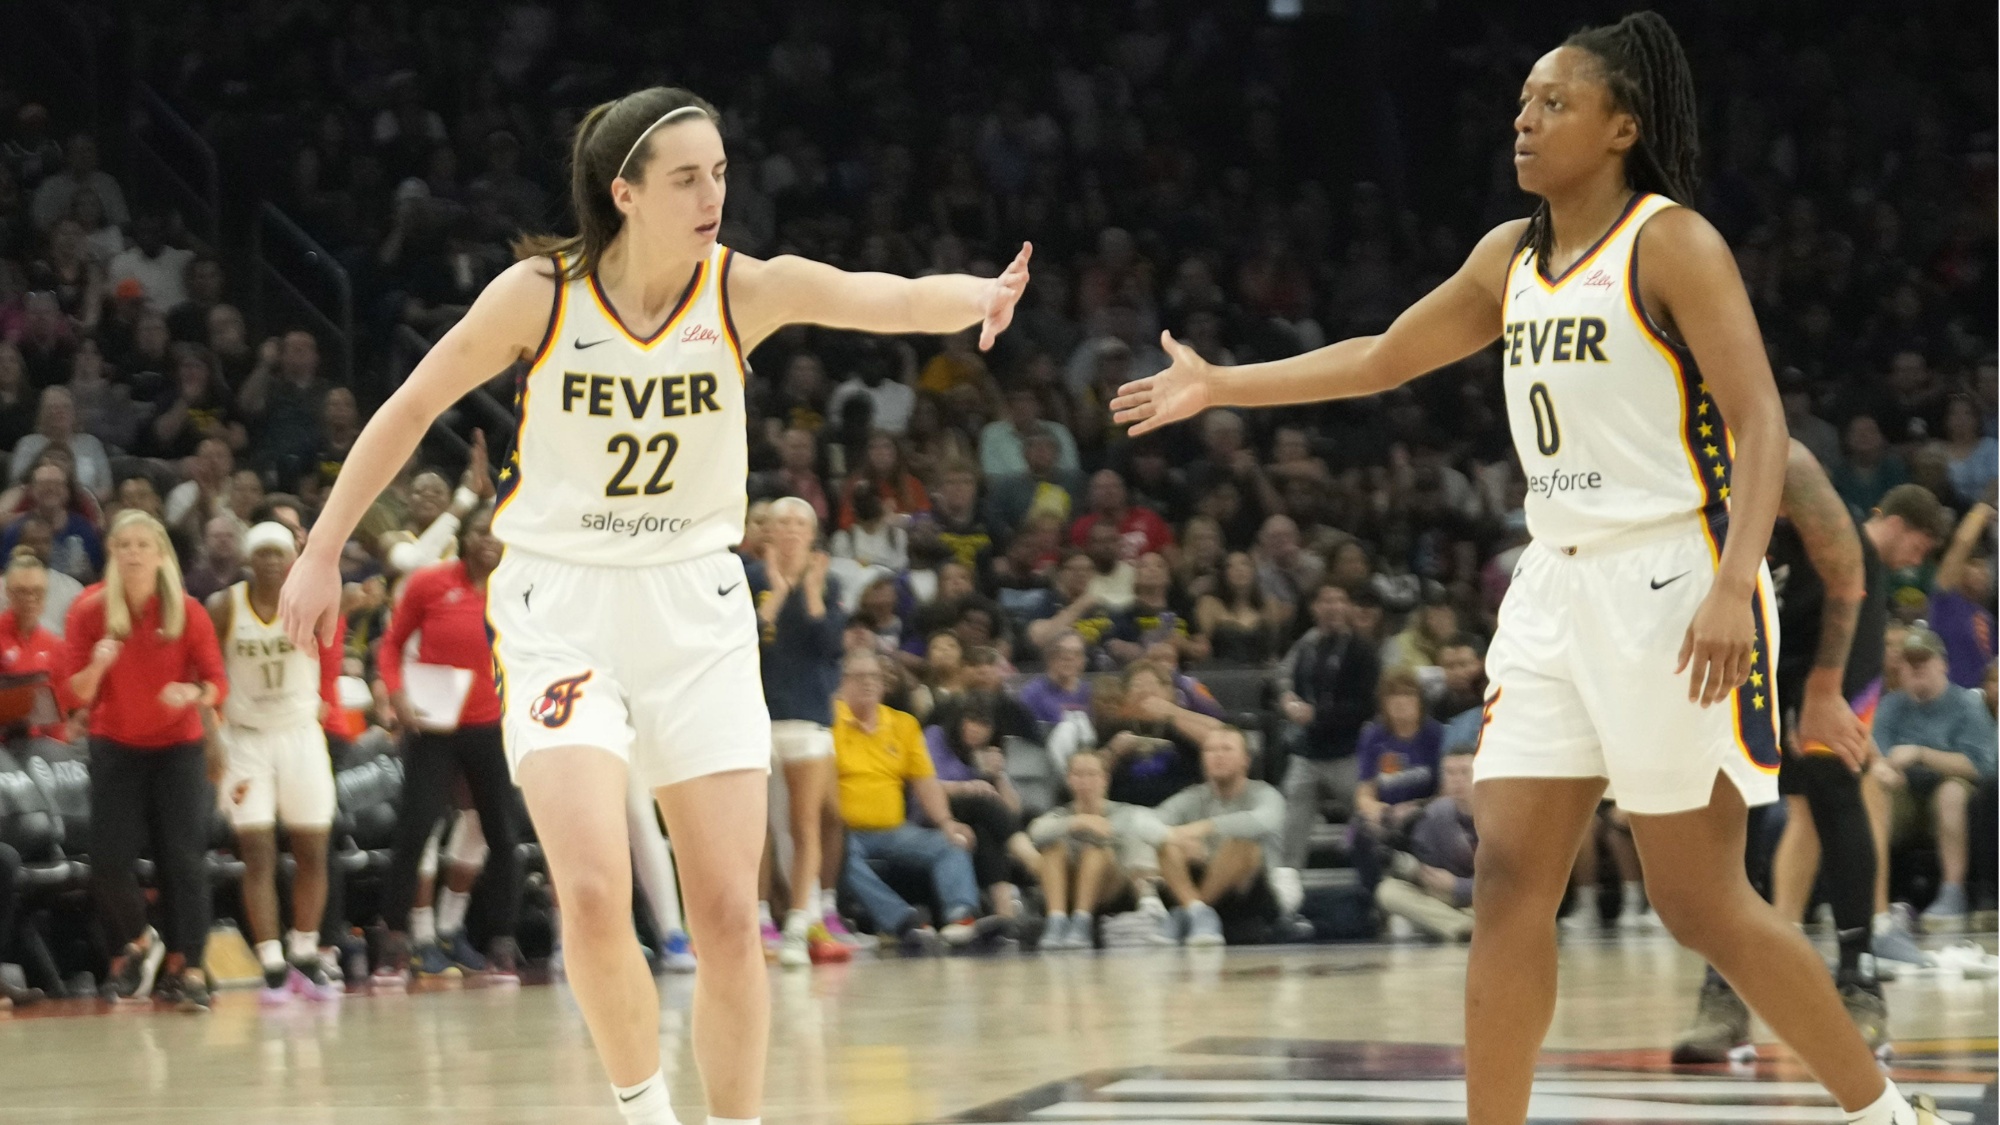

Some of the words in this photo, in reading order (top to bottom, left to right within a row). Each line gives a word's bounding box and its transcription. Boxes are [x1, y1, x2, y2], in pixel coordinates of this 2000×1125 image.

[681, 324, 719, 344] Lilly
[562, 371, 722, 420] FEVER
[1529, 381, 1561, 457] 0
[604, 432, 680, 497] 22
[261, 660, 285, 689] 17
